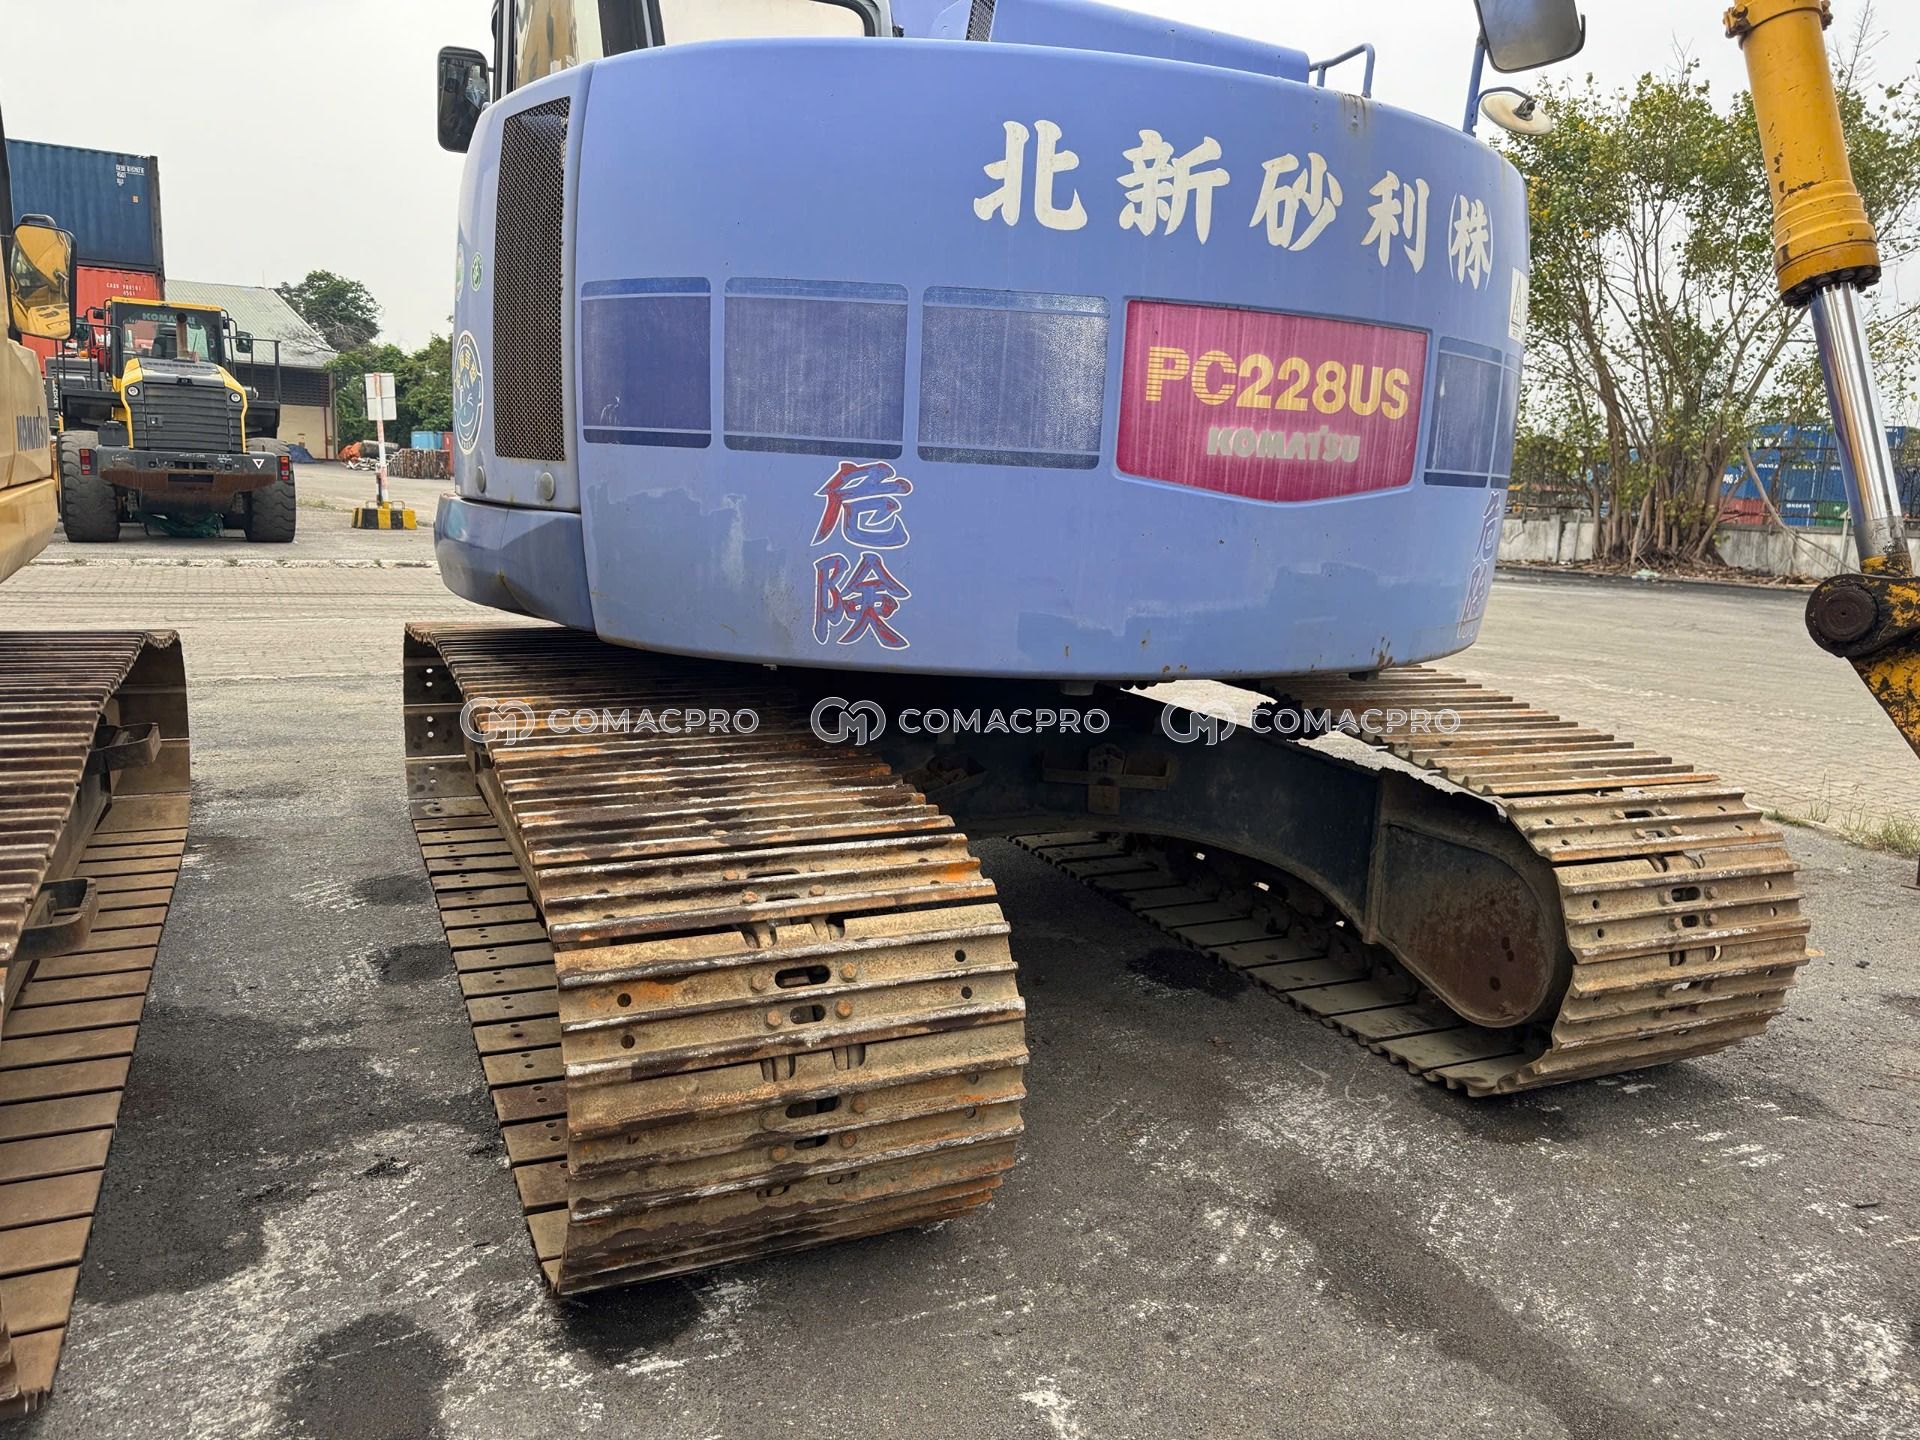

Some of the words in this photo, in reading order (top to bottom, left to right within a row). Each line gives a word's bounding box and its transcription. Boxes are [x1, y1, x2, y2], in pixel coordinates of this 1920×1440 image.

[142, 312, 196, 325] KOMAU
[1145, 346, 1410, 420] PC228US
[1206, 424, 1361, 463] KOMATSU
